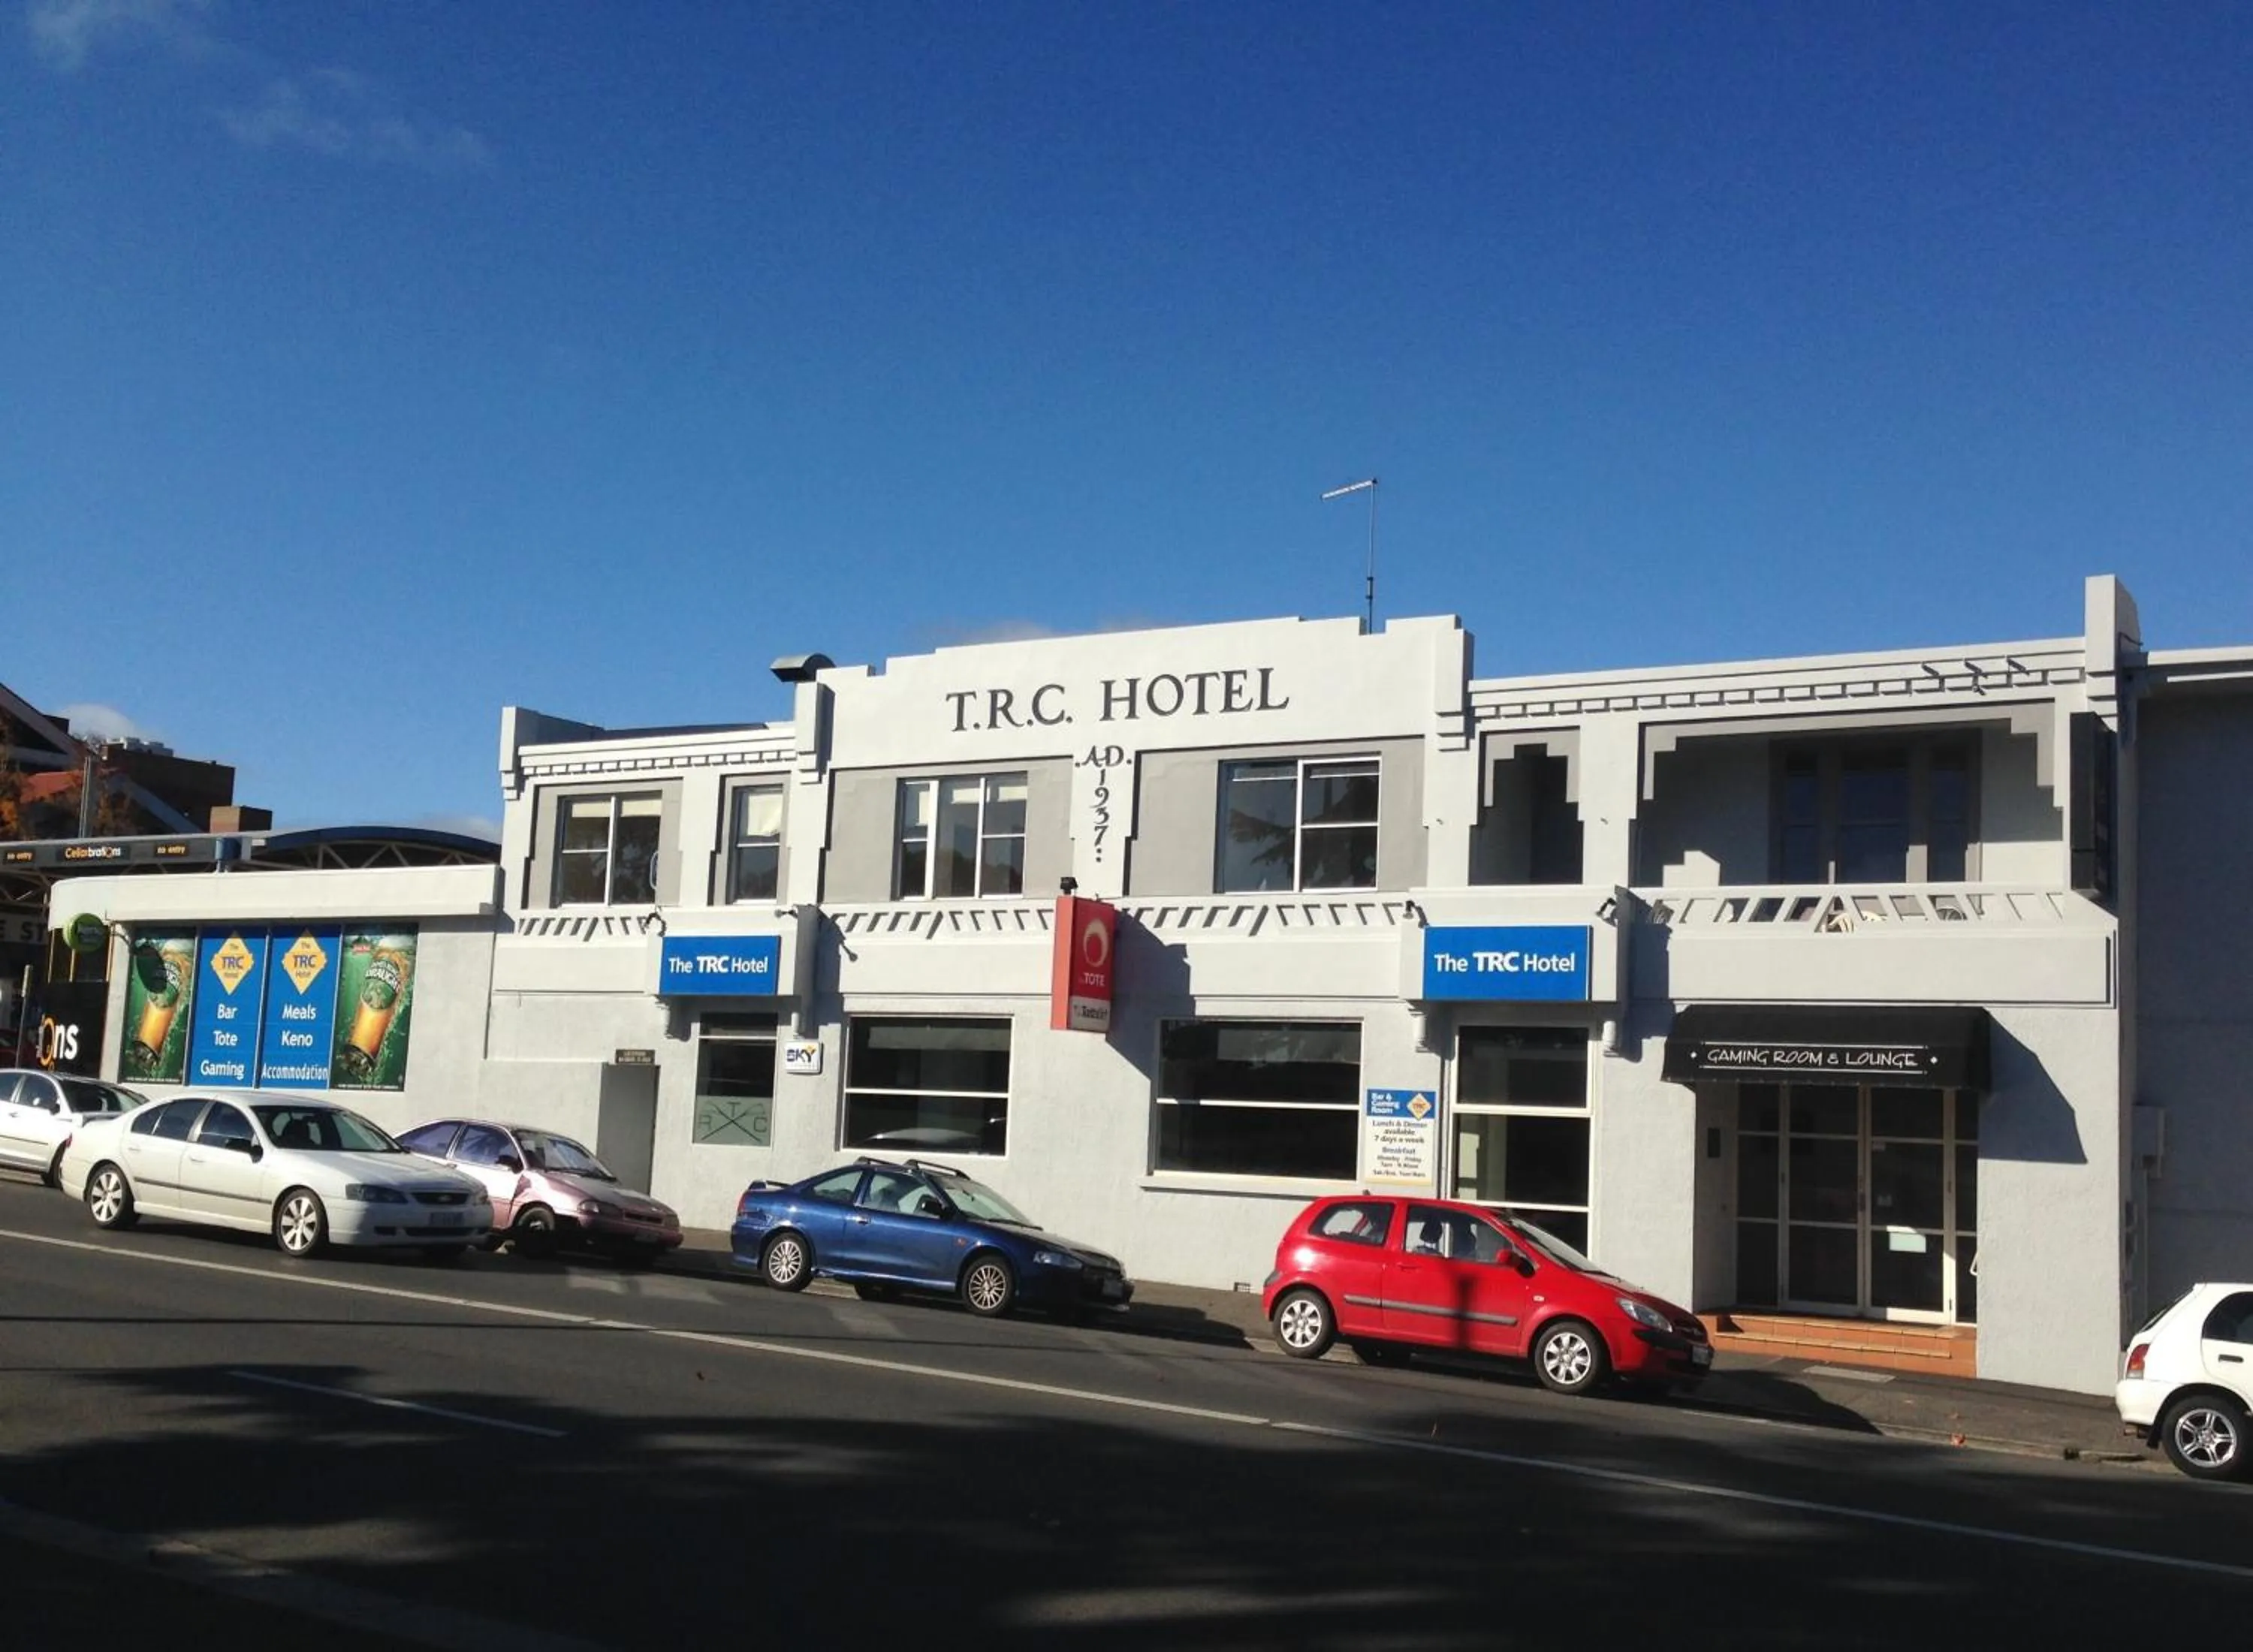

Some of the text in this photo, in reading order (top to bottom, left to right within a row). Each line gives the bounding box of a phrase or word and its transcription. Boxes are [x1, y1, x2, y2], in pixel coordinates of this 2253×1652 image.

[946, 667, 1289, 732] T.R.C. HOTEL
[222, 956, 244, 969] TRC
[294, 954, 317, 968] TRC
[668, 956, 768, 974] The TRC Hotel
[1434, 951, 1576, 972] The TRC Hotel
[1084, 972, 1105, 987] TOTE
[217, 1003, 238, 1019] Bar
[282, 1004, 316, 1020] Meals
[213, 1030, 238, 1046] Tote
[282, 1031, 313, 1046] Keno
[786, 1048, 816, 1063] SKY
[1707, 1048, 1919, 1069] GAMING ROOM & LOUNGE
[201, 1060, 245, 1081] Gaming
[262, 1063, 328, 1081] Accommodation
[1380, 1135, 1397, 1144] days
